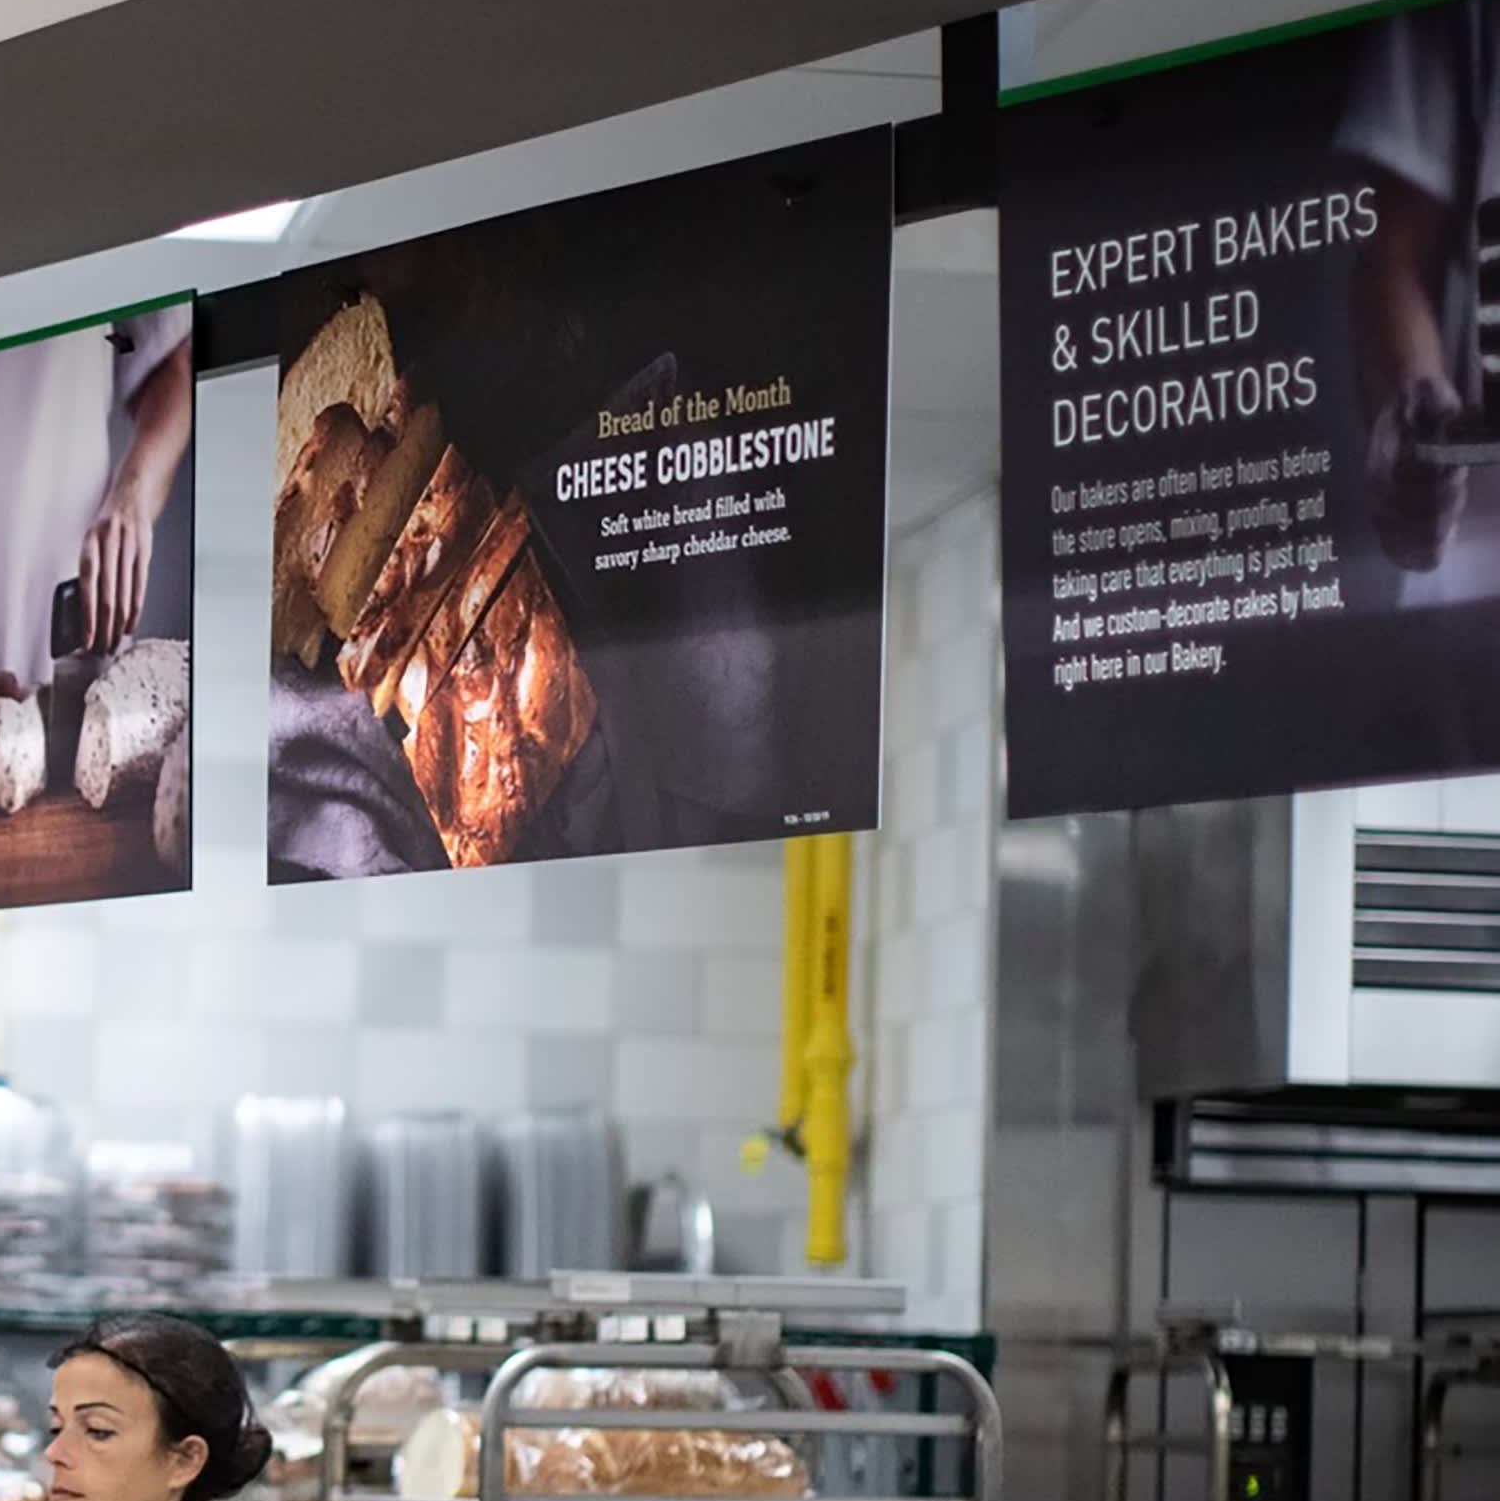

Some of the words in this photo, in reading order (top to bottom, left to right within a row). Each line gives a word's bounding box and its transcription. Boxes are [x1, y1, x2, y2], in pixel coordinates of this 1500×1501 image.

[1051, 222, 1201, 299] EXPERT
[1214, 187, 1378, 267] BAKERS
[1051, 324, 1078, 372] &
[1091, 289, 1259, 365] SKILLED
[597, 401, 654, 439] Bread
[660, 395, 683, 427] of
[686, 391, 719, 422] the
[725, 375, 792, 416] Month
[1053, 355, 1317, 448] DECORATORS
[556, 451, 648, 502] CHEESE
[657, 416, 836, 485] COBBLESTONE
[1051, 485, 1077, 514] Our
[1080, 480, 1129, 509] bakers
[1132, 480, 1155, 501] are
[1158, 469, 1197, 497] often
[1200, 463, 1233, 490] here
[1236, 456, 1279, 485] hours
[1282, 447, 1331, 478] before
[600, 513, 630, 537] Soft
[632, 508, 671, 531] white
[673, 498, 712, 525] bread
[715, 493, 750, 519] filled
[753, 487, 786, 512] with
[1053, 529, 1075, 556] the
[1079, 526, 1116, 553] store
[1296, 489, 1325, 521] and
[595, 548, 640, 571] savory
[641, 541, 681, 564] sharp
[683, 530, 740, 557] cheddar
[741, 522, 792, 548] cheese.
[1053, 570, 1098, 602] taking
[1101, 571, 1132, 593] care
[1136, 560, 1165, 588] that
[1168, 549, 1245, 587] everything
[1248, 546, 1262, 572] is
[1264, 541, 1294, 578] just
[1052, 612, 1080, 642] And
[1083, 615, 1105, 638] we
[1107, 597, 1231, 635] custom-decorate
[1233, 590, 1278, 620] cakes
[1281, 584, 1300, 620] by
[1054, 656, 1088, 691] right
[1091, 652, 1123, 680] here
[1126, 649, 1141, 676] in
[1144, 651, 1169, 675] our
[1171, 641, 1227, 674] Bakery.
